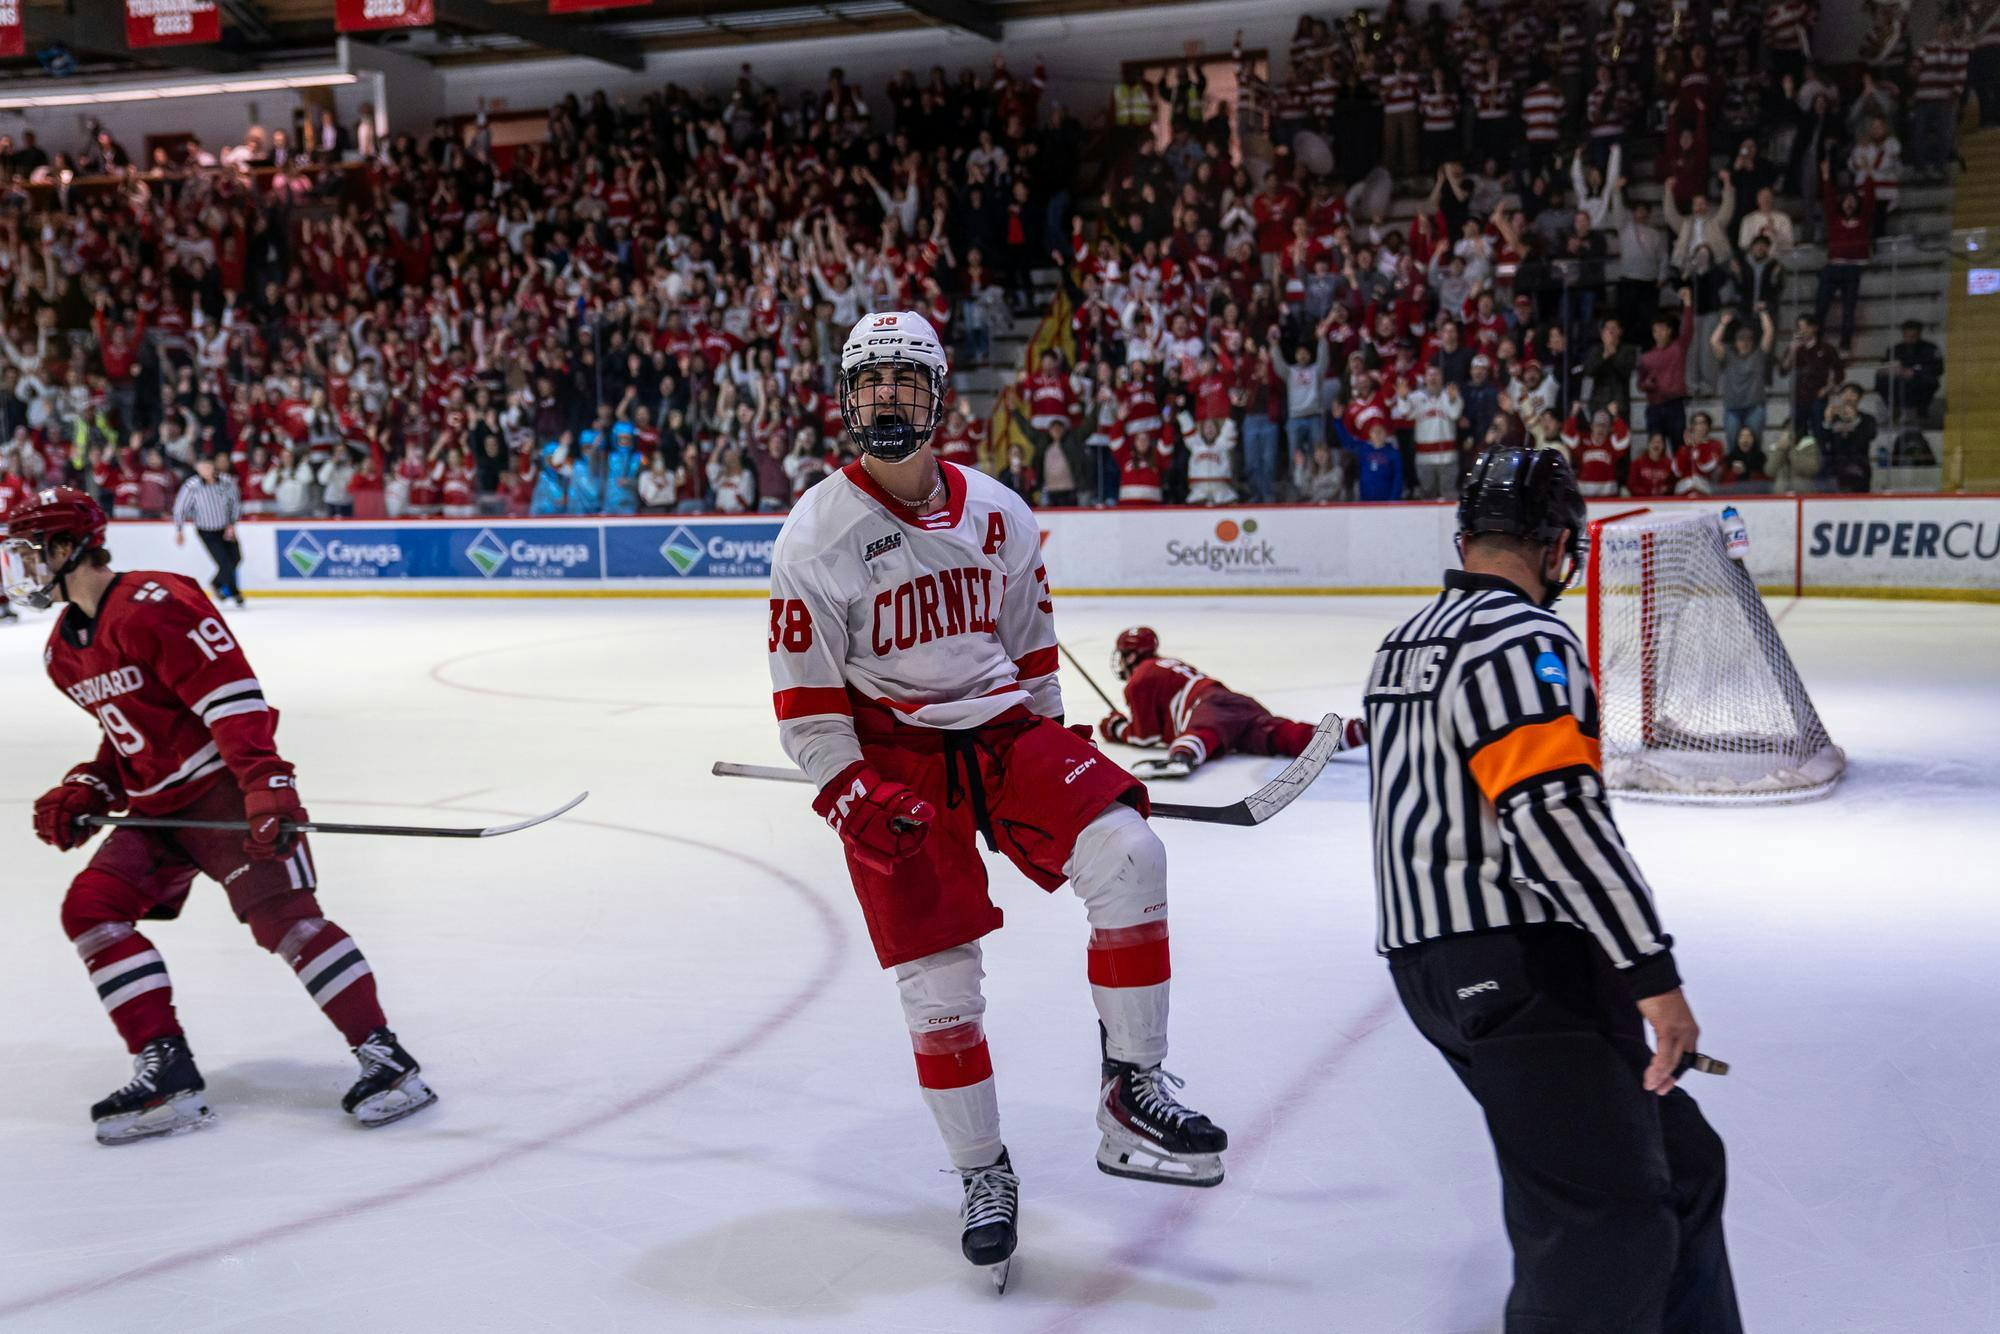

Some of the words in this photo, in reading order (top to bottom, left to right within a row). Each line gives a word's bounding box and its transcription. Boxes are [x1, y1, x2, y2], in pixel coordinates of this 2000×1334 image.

[873, 317, 898, 327] 38
[868, 337, 903, 346] CCM
[866, 532, 902, 554] ECAC
[982, 511, 1007, 555] A
[326, 540, 402, 567] Cayuga
[511, 539, 589, 566] Cayuga
[708, 536, 775, 564] Cayug
[1166, 539, 1275, 571] Sedgwick
[769, 598, 813, 653] 38
[872, 567, 1007, 657] CORNEL
[186, 616, 236, 662] 19
[1065, 757, 1097, 785] CCM
[825, 778, 868, 833] CM
[928, 1015, 960, 1025] CCM
[1130, 1116, 1164, 1140] BAUER
